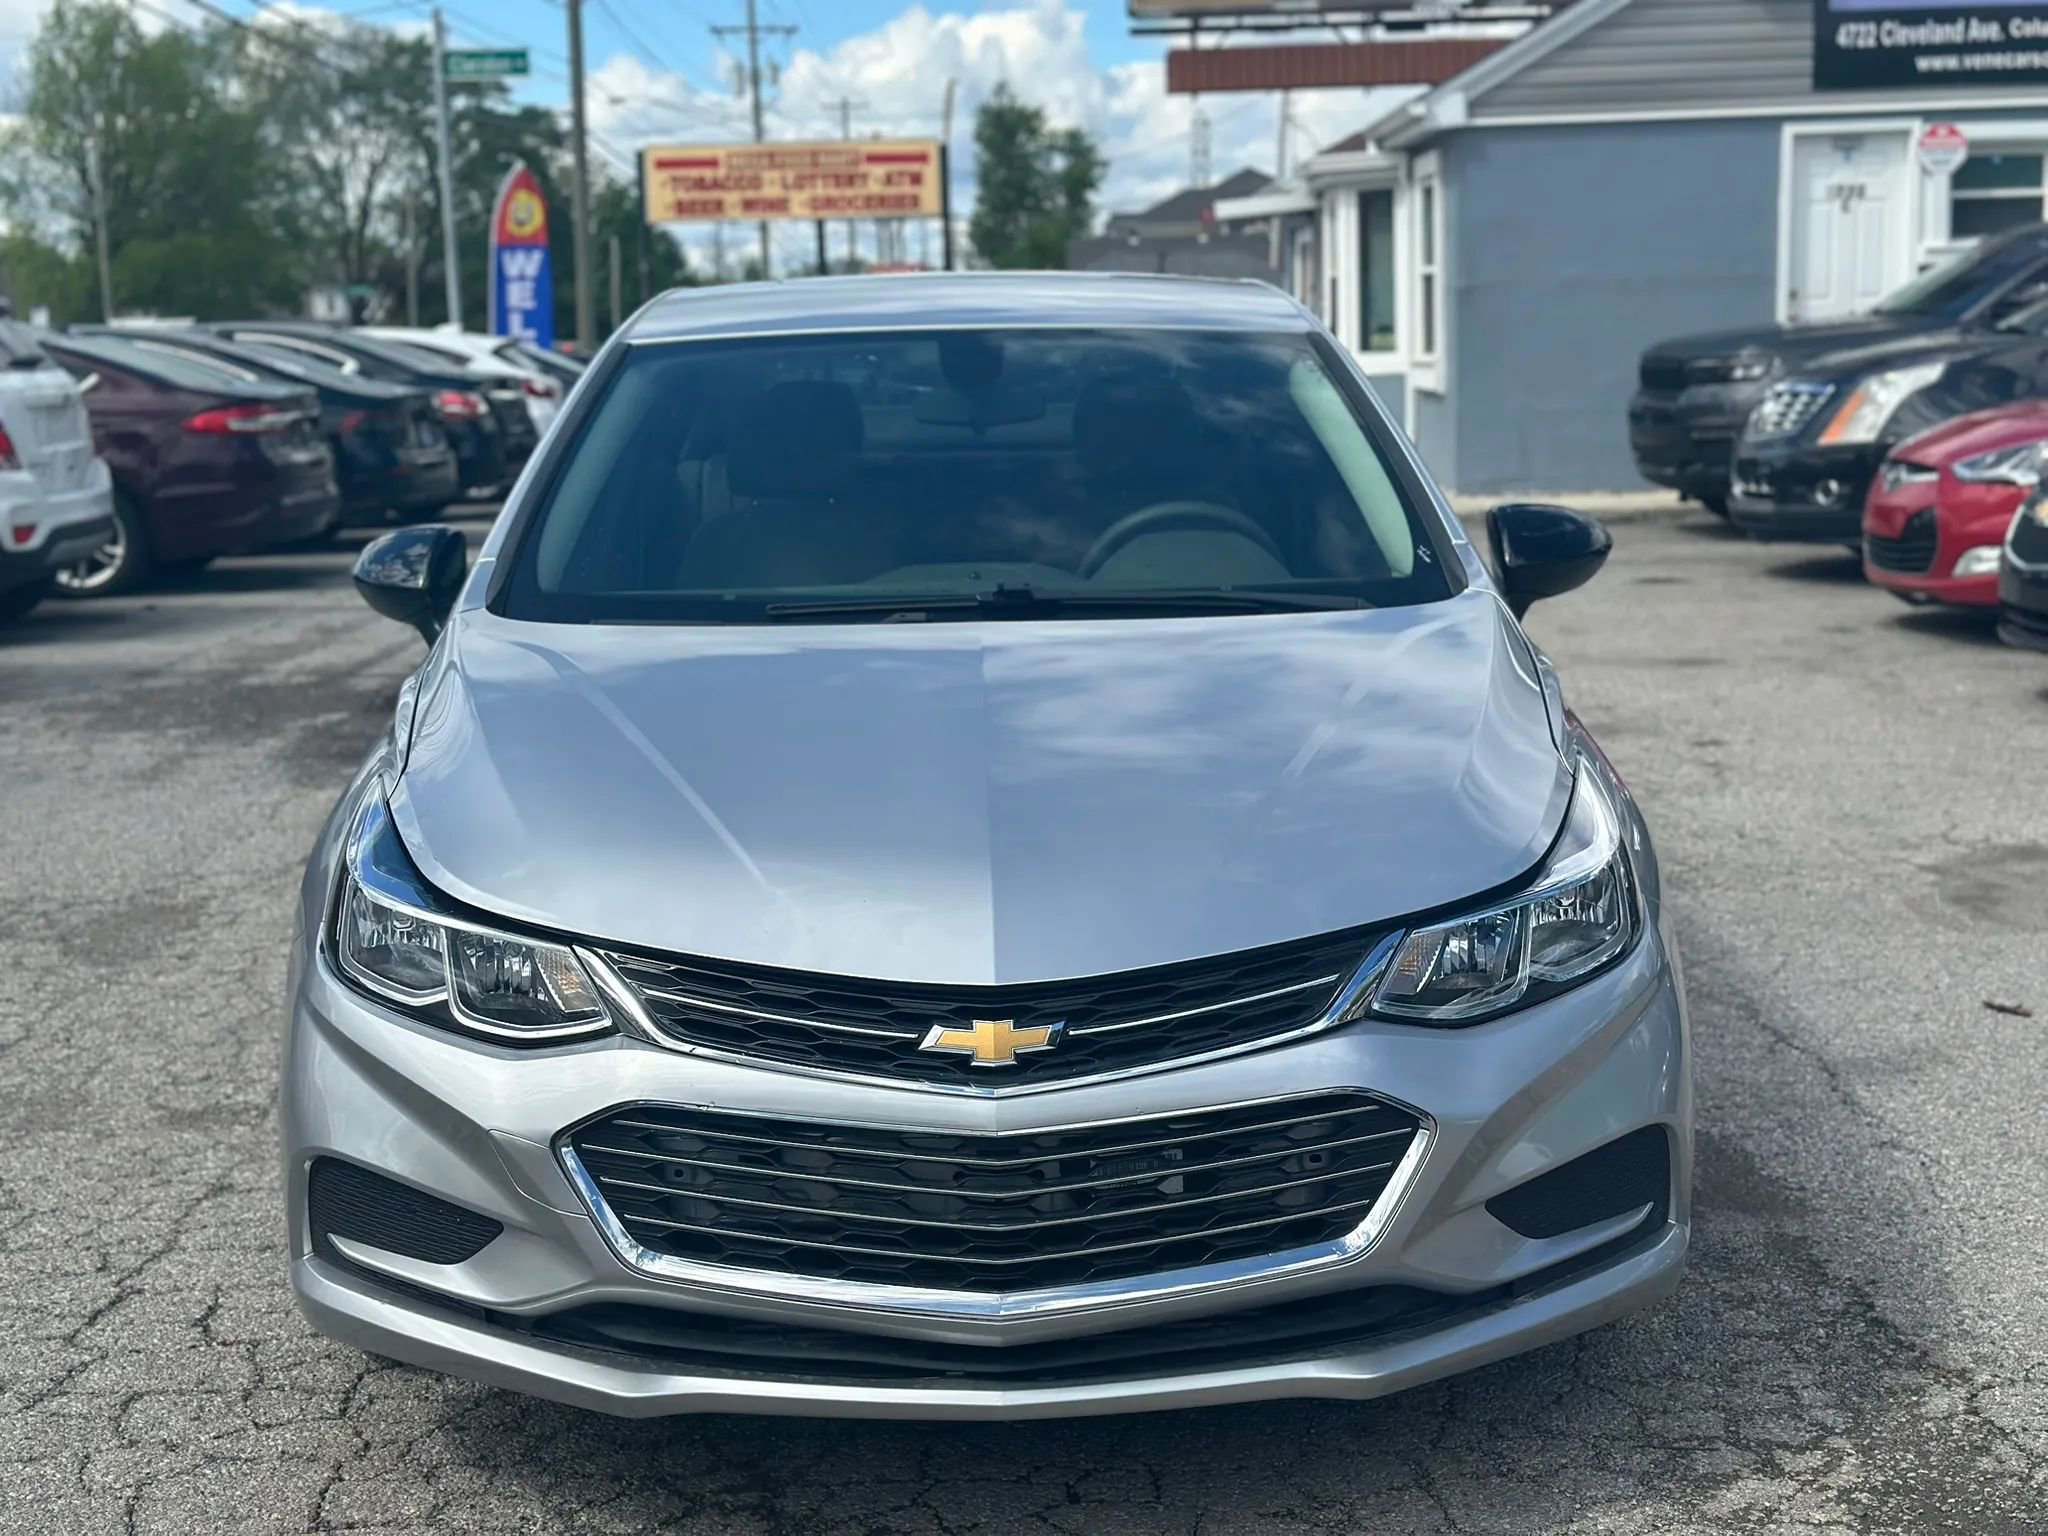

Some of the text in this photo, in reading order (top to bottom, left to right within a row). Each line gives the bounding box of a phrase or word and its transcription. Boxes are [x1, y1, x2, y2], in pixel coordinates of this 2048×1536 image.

[1835, 22, 1878, 48] 4722
[1879, 17, 1966, 47] Cleveland
[1967, 17, 2005, 43] Ave.
[670, 170, 923, 193] TOBACCO LOTTERY ATM
